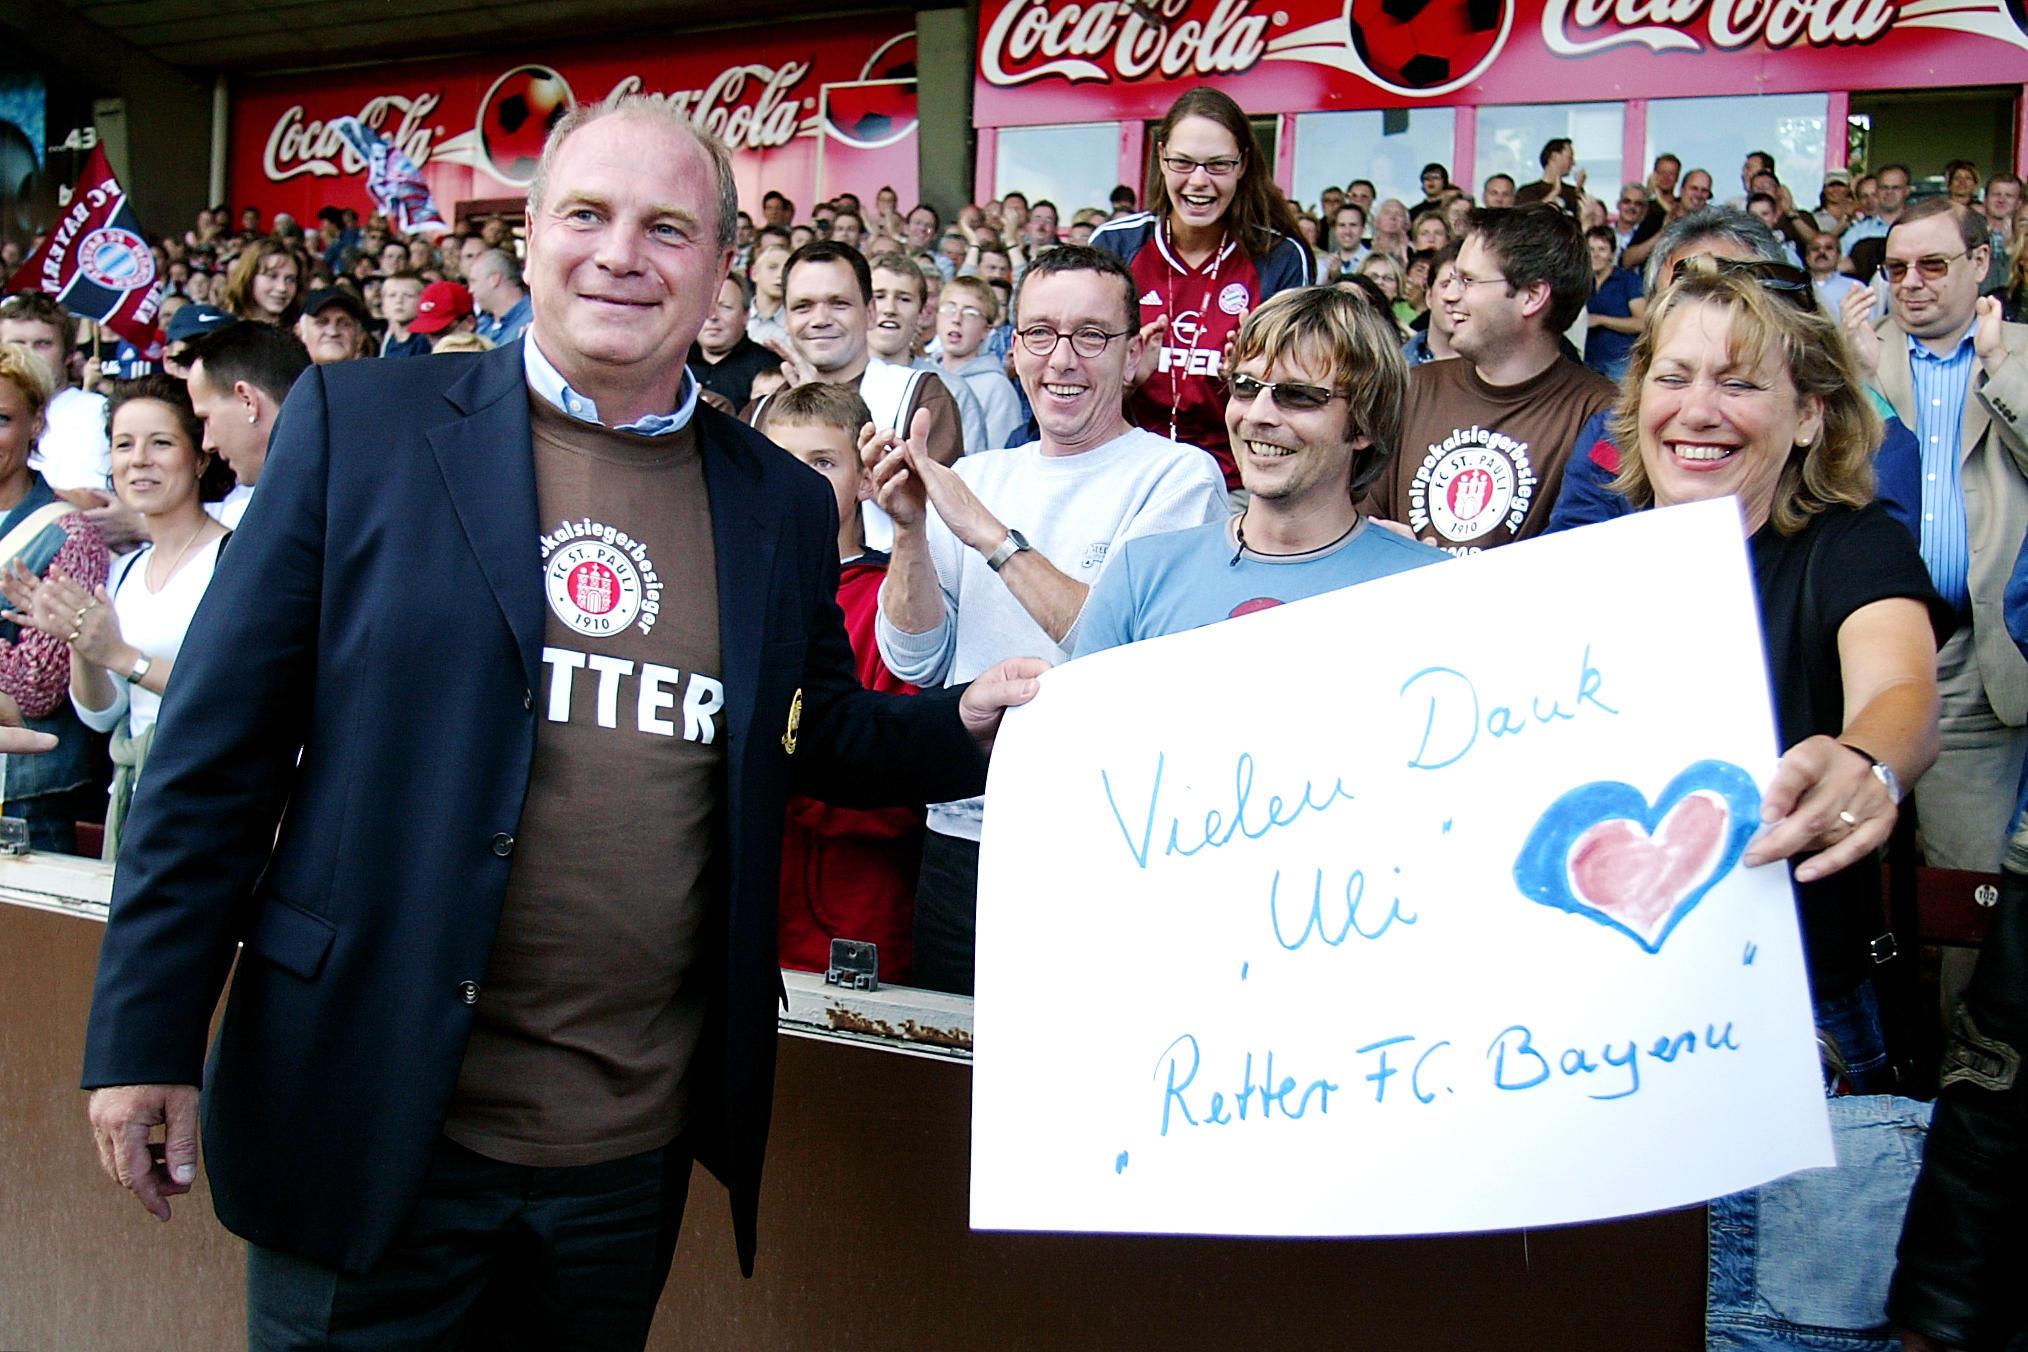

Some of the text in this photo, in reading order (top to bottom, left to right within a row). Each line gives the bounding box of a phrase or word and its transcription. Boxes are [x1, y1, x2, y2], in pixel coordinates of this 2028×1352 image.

[1409, 425, 1537, 535] Weltpokalsiegerbesieger
[1435, 455, 1507, 490] FC ST. PAULI
[1450, 521, 1478, 535] 1910
[553, 548, 634, 593] FC ST. PAULI
[575, 613, 610, 630] 1910
[542, 646, 725, 745] TTER
[1102, 643, 1619, 869] Vielen Dank
[1487, 1021, 1741, 1100] Bayern
